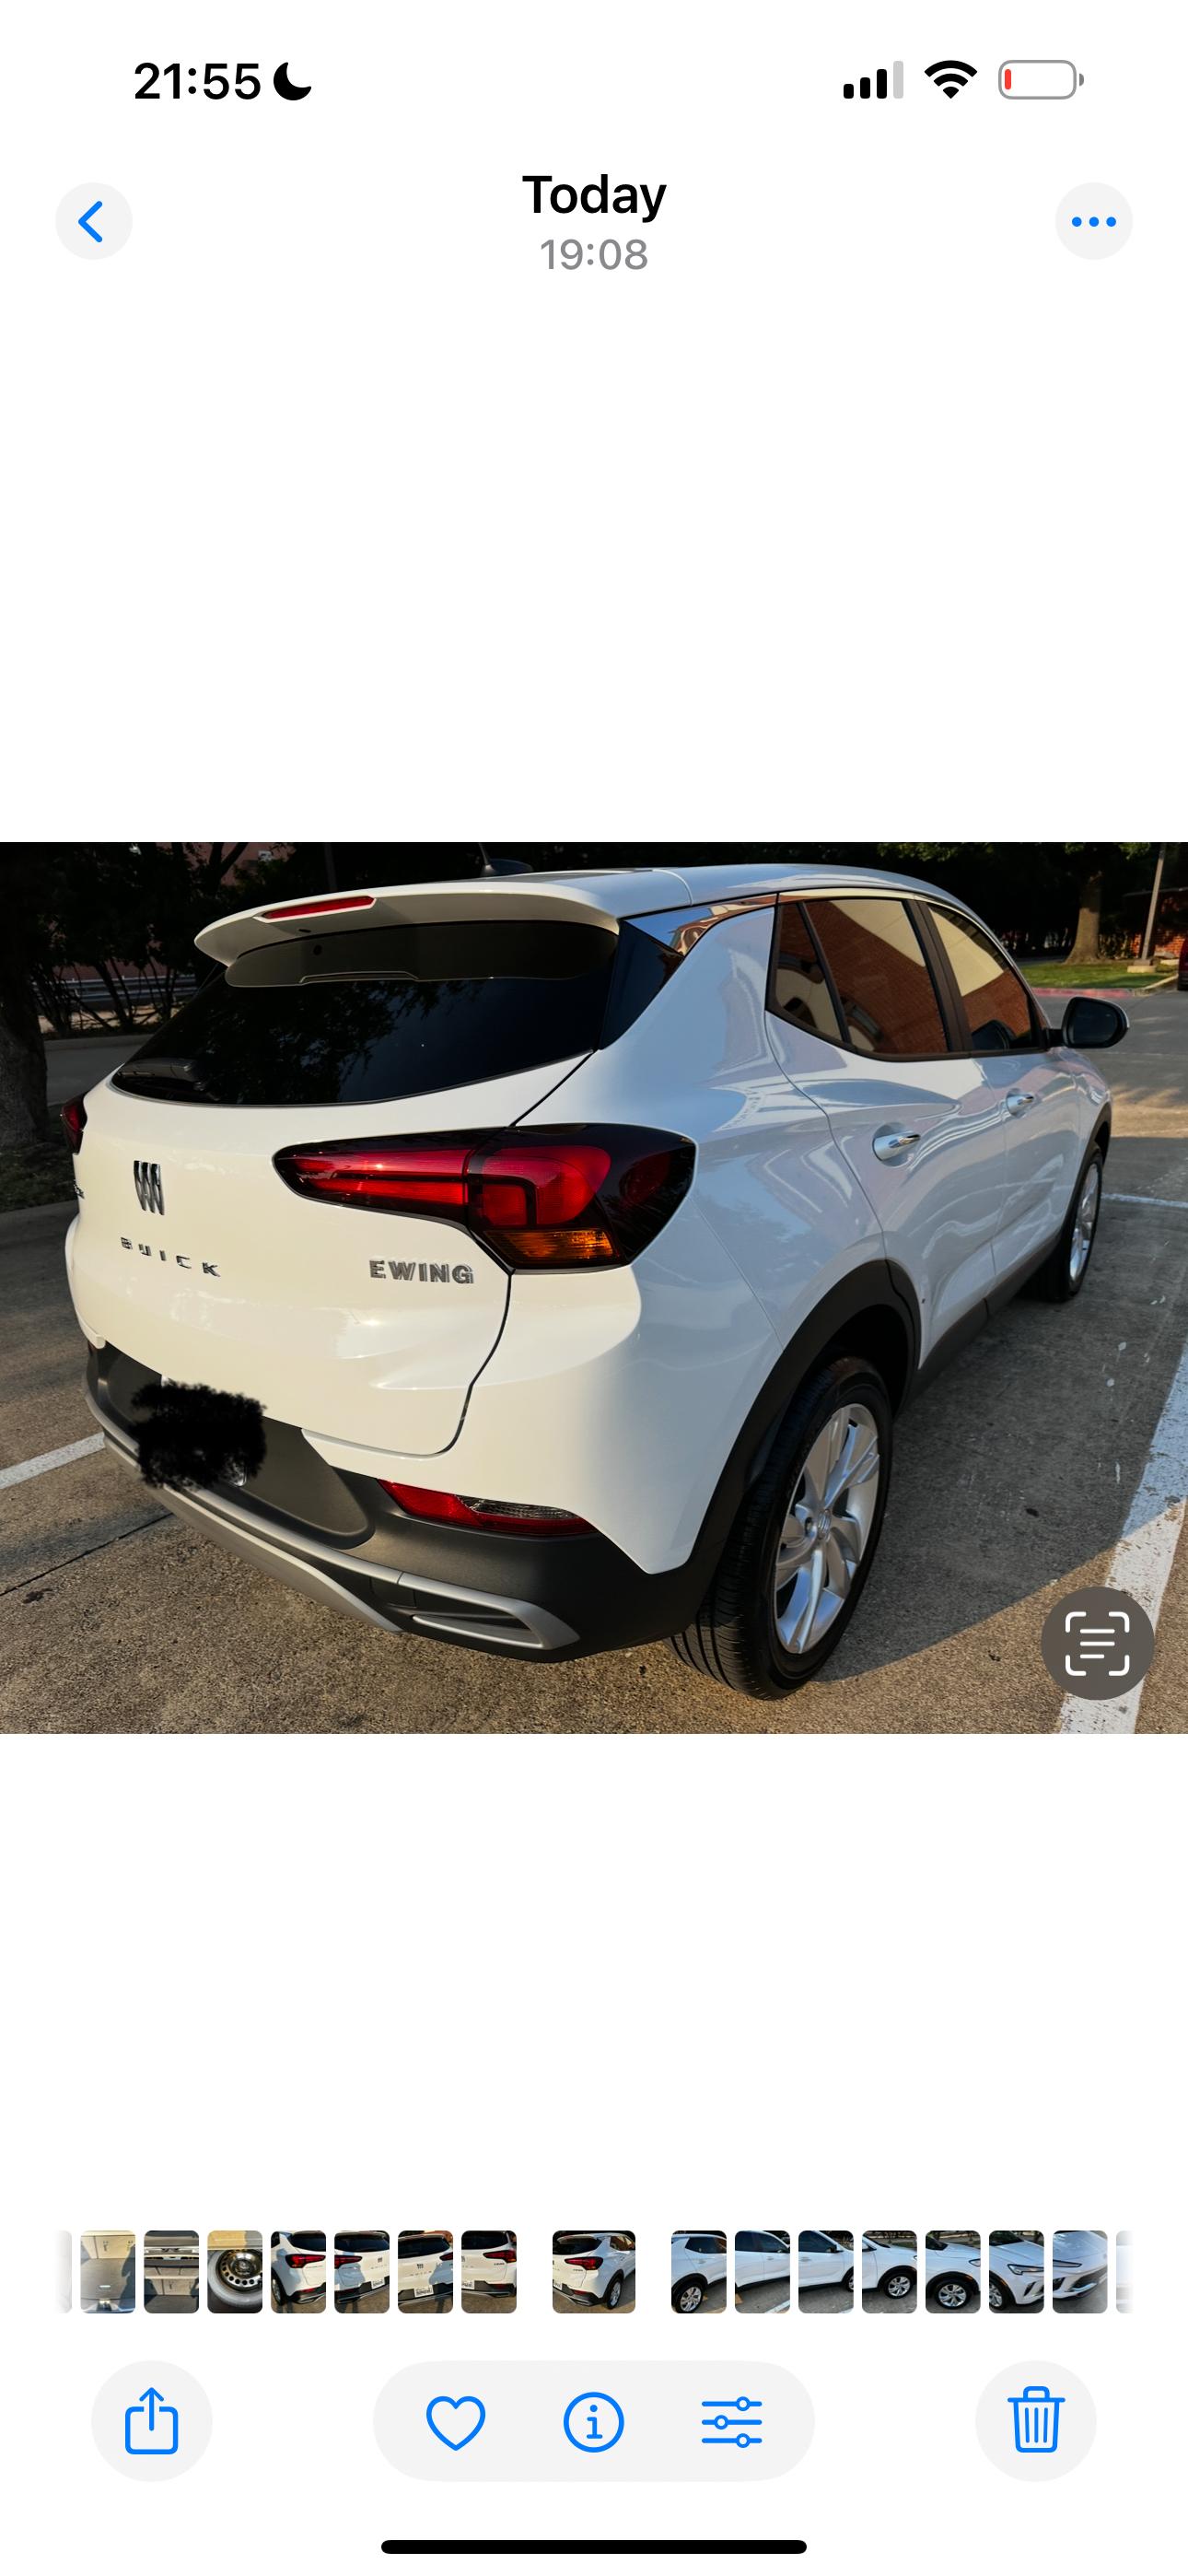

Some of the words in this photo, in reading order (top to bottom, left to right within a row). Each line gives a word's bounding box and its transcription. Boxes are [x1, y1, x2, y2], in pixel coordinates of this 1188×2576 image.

[134, 62, 262, 100] 21:55
[521, 173, 668, 224] Today
[541, 239, 648, 271] 19:08
[120, 1236, 221, 1277] BUICK
[368, 1259, 474, 1284] EWING
